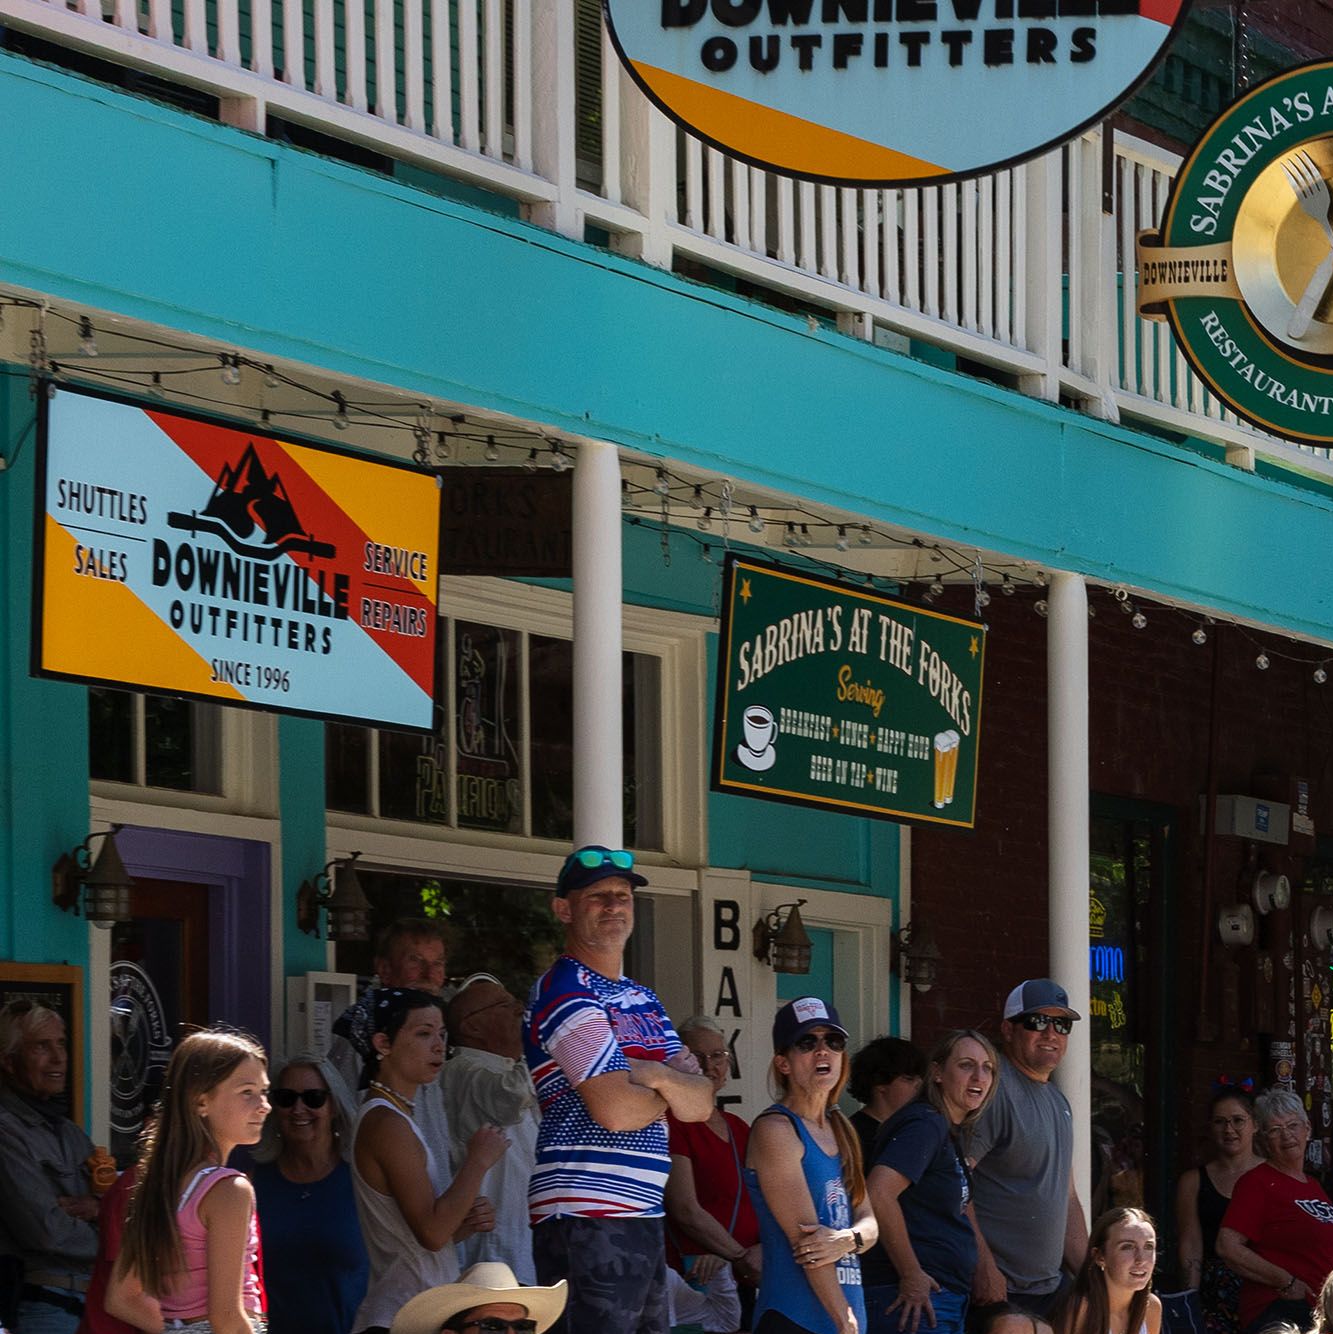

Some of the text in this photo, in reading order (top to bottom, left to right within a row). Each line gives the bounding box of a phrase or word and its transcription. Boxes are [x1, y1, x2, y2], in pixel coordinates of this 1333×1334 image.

[701, 28, 1096, 74] OUTFITTERS
[1190, 92, 1314, 236] SABRINA'S
[1143, 259, 1228, 287] DOWNIEVILLE
[57, 478, 147, 525] SHUTTLES
[74, 543, 128, 583] SALES
[152, 538, 349, 620] DOWNIEVILLE
[363, 541, 428, 582] SERVICE
[170, 600, 332, 655] OUTFITTERS
[360, 597, 428, 638] REPAIRS
[210, 658, 291, 693] SINCE 1996
[736, 605, 972, 736] SABRINA'S AT THE FORKS
[836, 664, 886, 718] Serving
[779, 707, 930, 760] BREAKFAST LUNCH HAPPY HOUR
[810, 755, 899, 794] BEER ON TAP WINE
